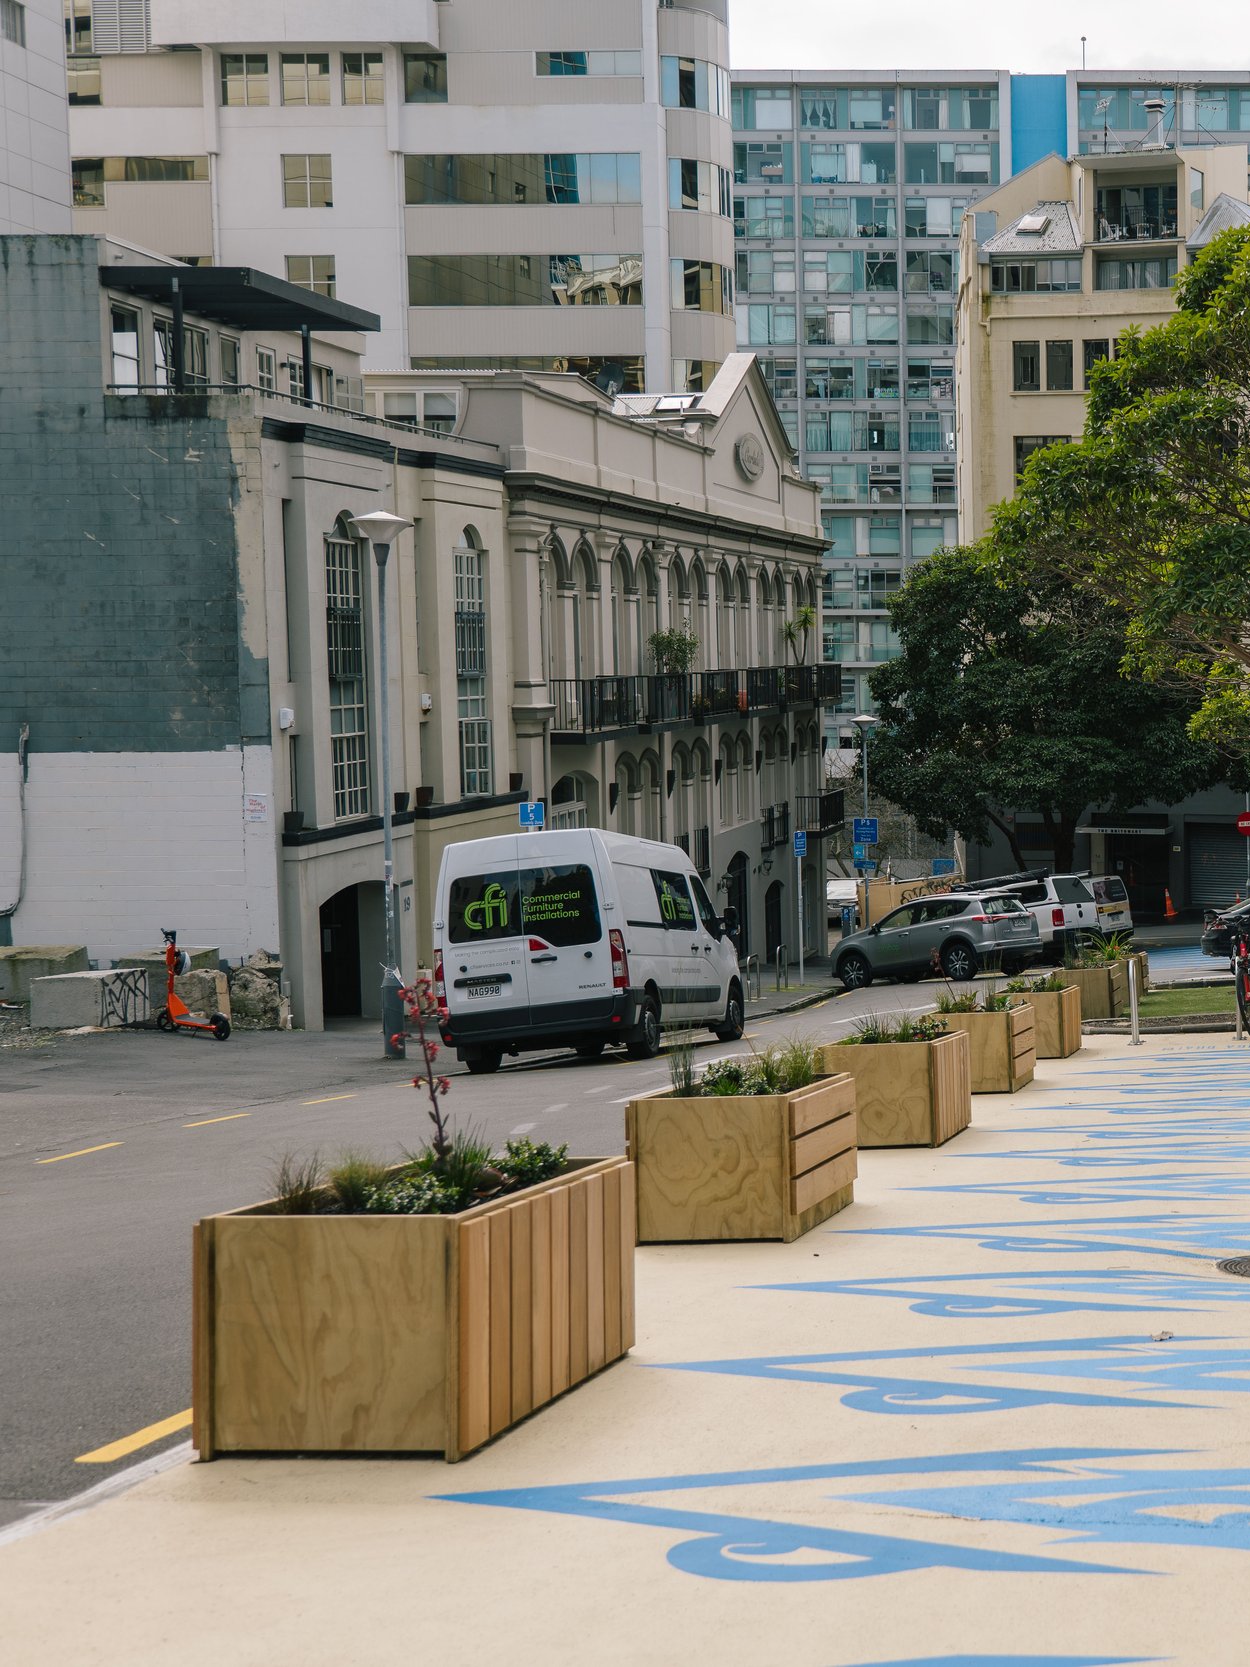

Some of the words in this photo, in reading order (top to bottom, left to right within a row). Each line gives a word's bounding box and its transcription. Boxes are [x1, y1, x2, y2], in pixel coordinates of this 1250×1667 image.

[527, 804, 535, 813] P
[522, 890, 580, 904] Commercial
[403, 896, 411, 912] 19
[464, 882, 508, 930] cfi
[522, 901, 564, 913] Furniture
[523, 909, 580, 922] Installations
[468, 985, 500, 997] NAG990
